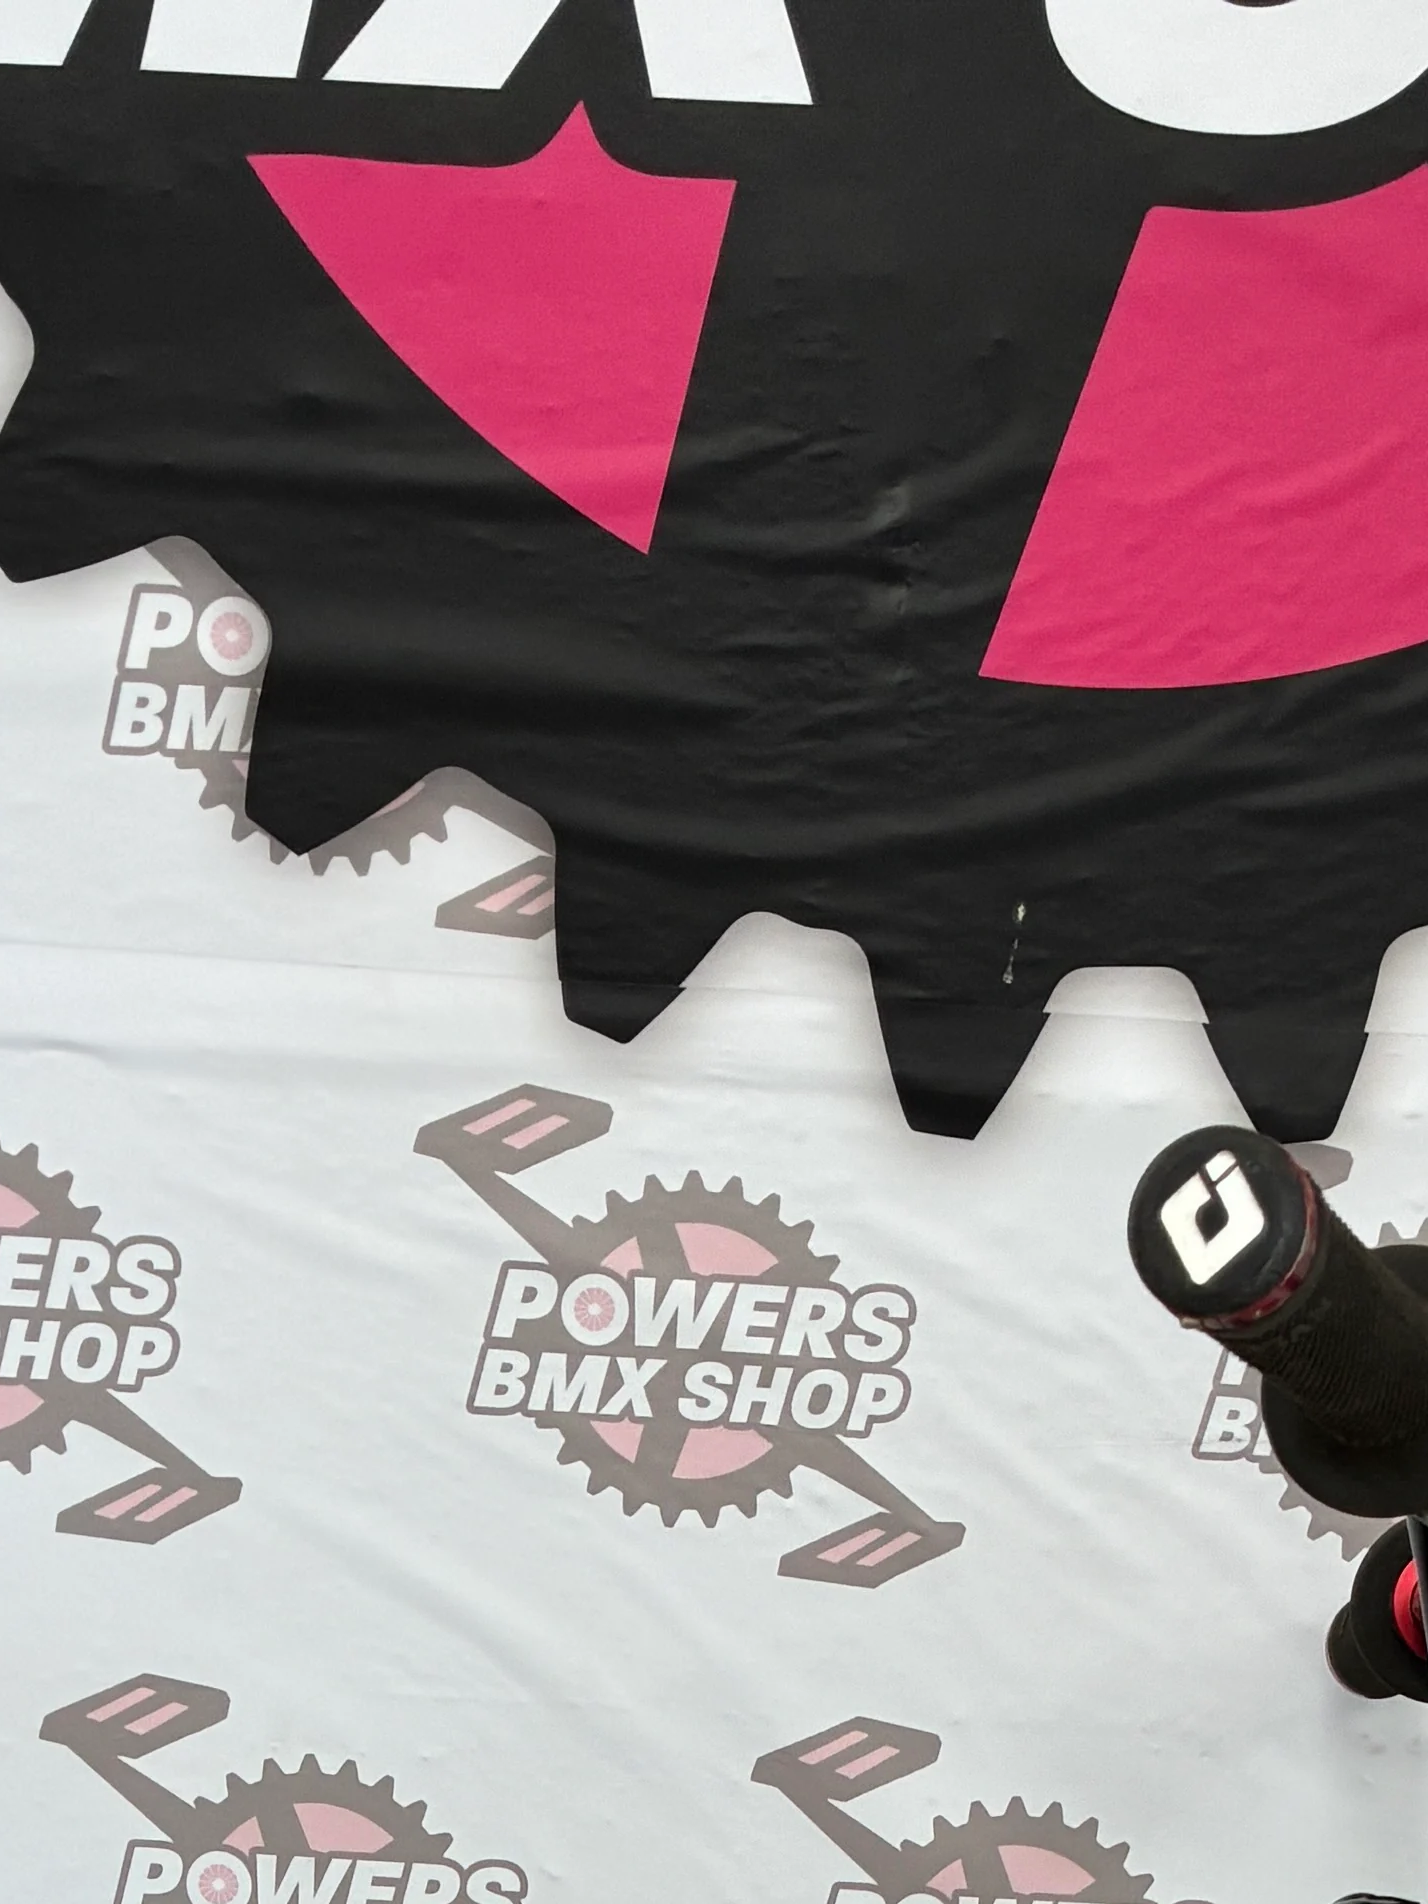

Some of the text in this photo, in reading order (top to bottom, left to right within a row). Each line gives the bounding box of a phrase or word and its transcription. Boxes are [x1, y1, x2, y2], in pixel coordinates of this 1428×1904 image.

[110, 684, 253, 752] BM
[491, 1269, 909, 1361] POWERS
[474, 1350, 909, 1431] BMX SHOP
